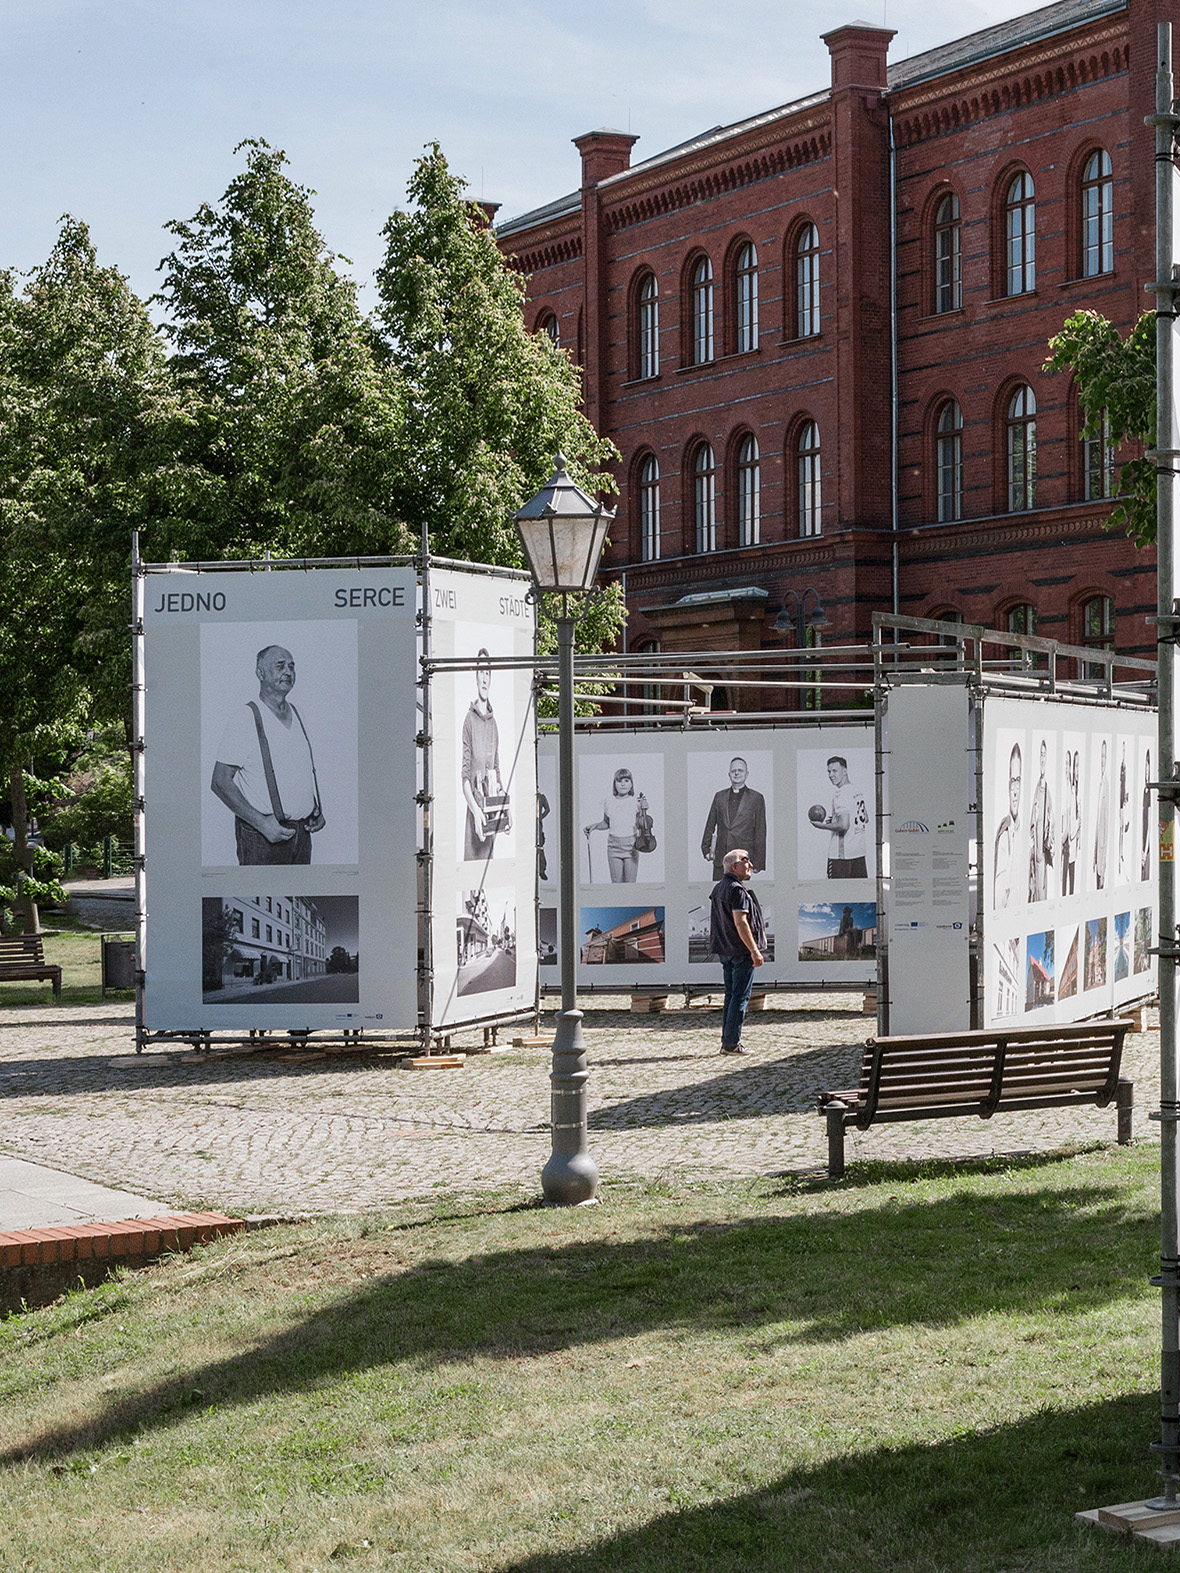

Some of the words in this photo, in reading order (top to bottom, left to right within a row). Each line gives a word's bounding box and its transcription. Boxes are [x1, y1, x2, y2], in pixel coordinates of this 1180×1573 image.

[154, 591, 226, 612] JEDNO
[334, 586, 406, 607] SERCE
[434, 588, 457, 609] ZWEI
[499, 594, 530, 618] STÄDTE
